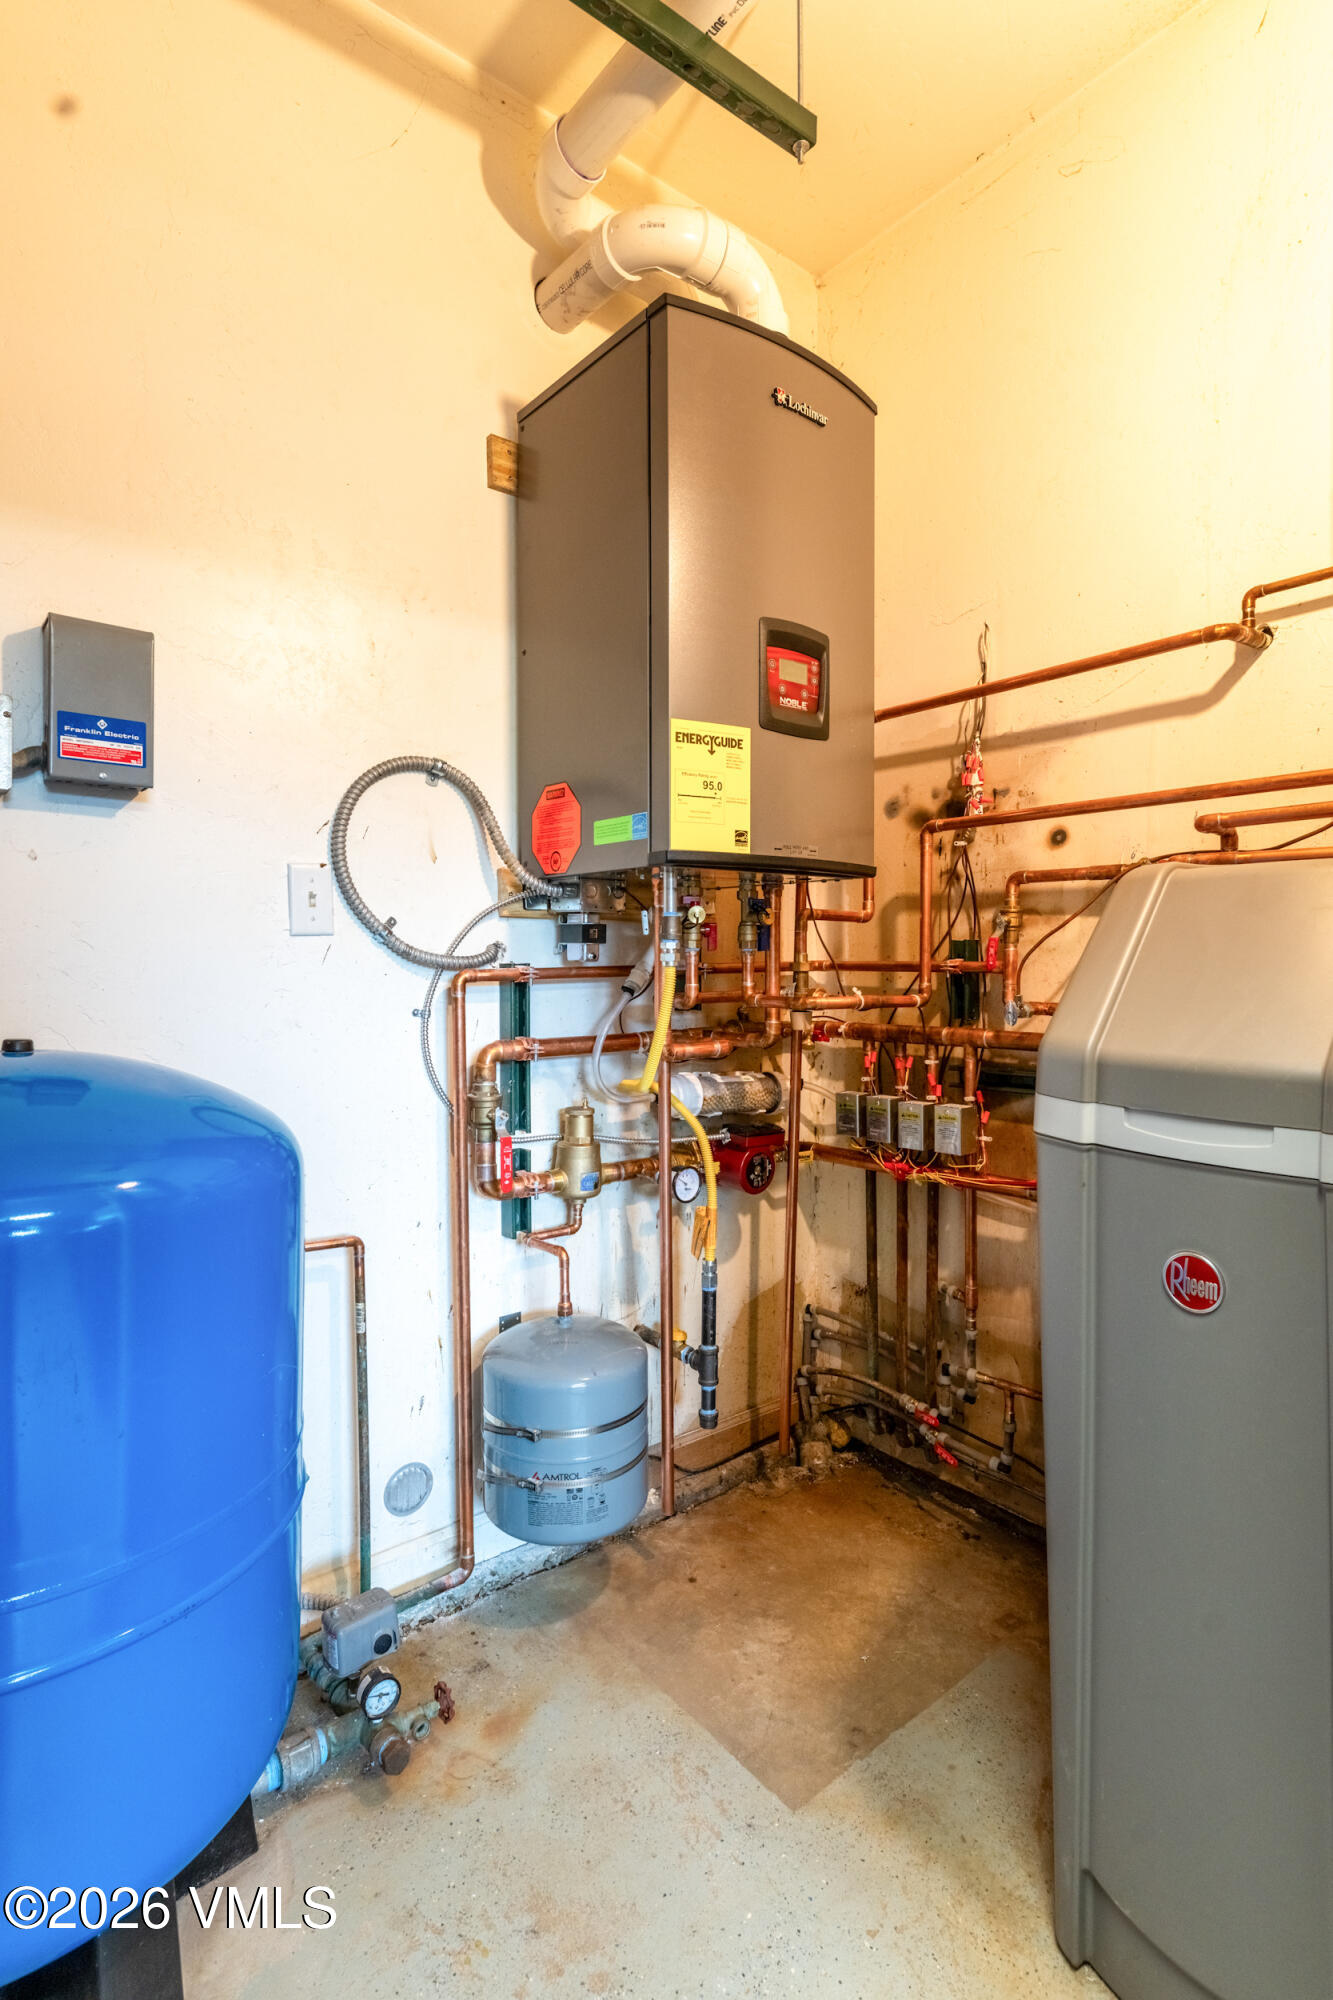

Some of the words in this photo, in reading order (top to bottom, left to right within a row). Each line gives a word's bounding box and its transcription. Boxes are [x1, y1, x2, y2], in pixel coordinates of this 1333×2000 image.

[788, 394, 829, 425] Lochinvar
[779, 696, 808, 709] NOBLE
[63, 725, 102, 736] Franklin
[104, 730, 140, 741] Electric
[675, 731, 744, 752] ENERGYGUIDE
[702, 780, 723, 792] 95.0
[1170, 1257, 1218, 1302] Rheem
[542, 1472, 581, 1481] AMTROL
